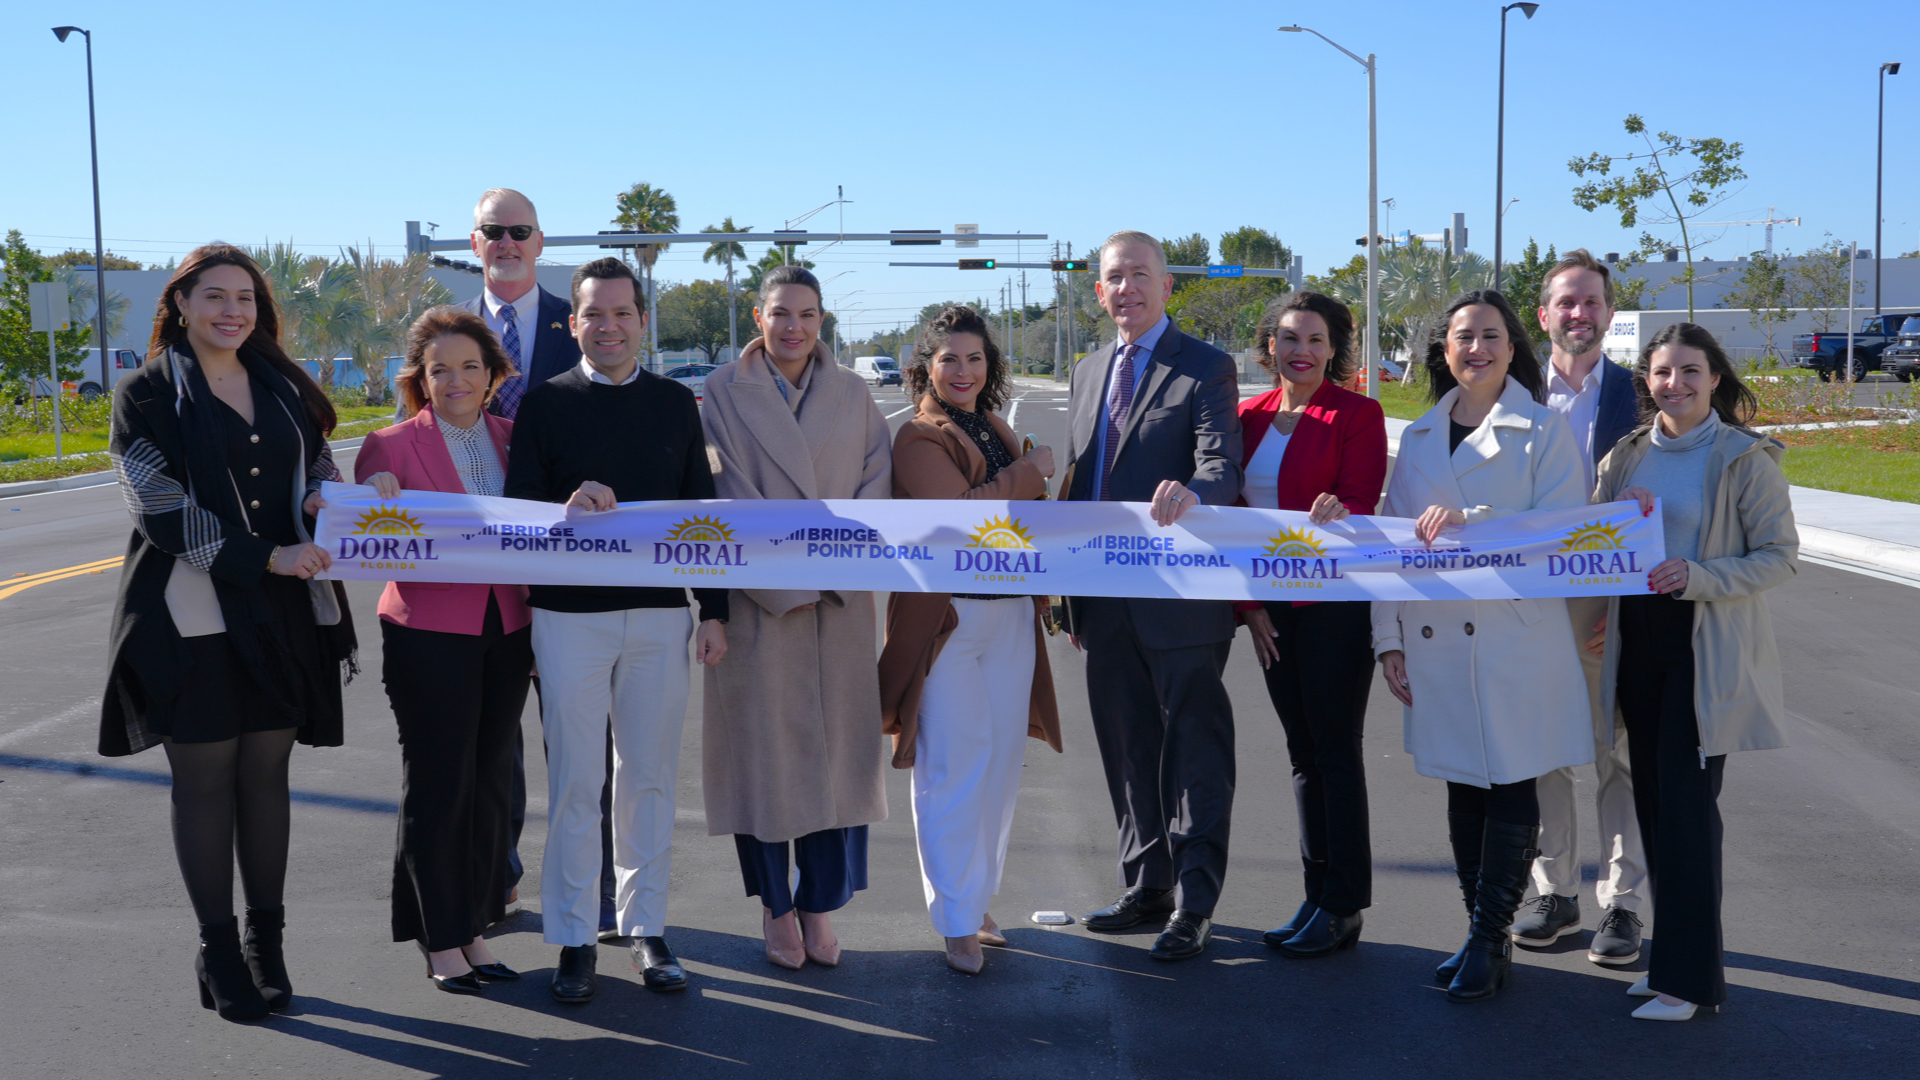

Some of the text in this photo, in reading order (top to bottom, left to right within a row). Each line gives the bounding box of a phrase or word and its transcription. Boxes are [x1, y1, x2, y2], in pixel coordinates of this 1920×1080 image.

[1614, 322, 1635, 336] BRIDGE
[501, 524, 574, 537] BRIDGE
[808, 528, 878, 542] BRIDGE
[338, 537, 439, 560] DORAL
[501, 537, 632, 553] POINT DORAL
[1105, 535, 1174, 551] BRIDGE
[653, 542, 748, 566] DORAL
[807, 543, 934, 560] POINT DORAL
[1105, 551, 1231, 567] POINT DORAL
[954, 549, 1047, 573] DORAL
[1250, 557, 1344, 579] DORAL
[1402, 553, 1526, 569] POINT DORAL
[1547, 550, 1643, 576] DORAL
[674, 567, 726, 575] FLORIDA
[974, 574, 1026, 582] FLORIDA
[1569, 576, 1622, 585] FLORIDA
